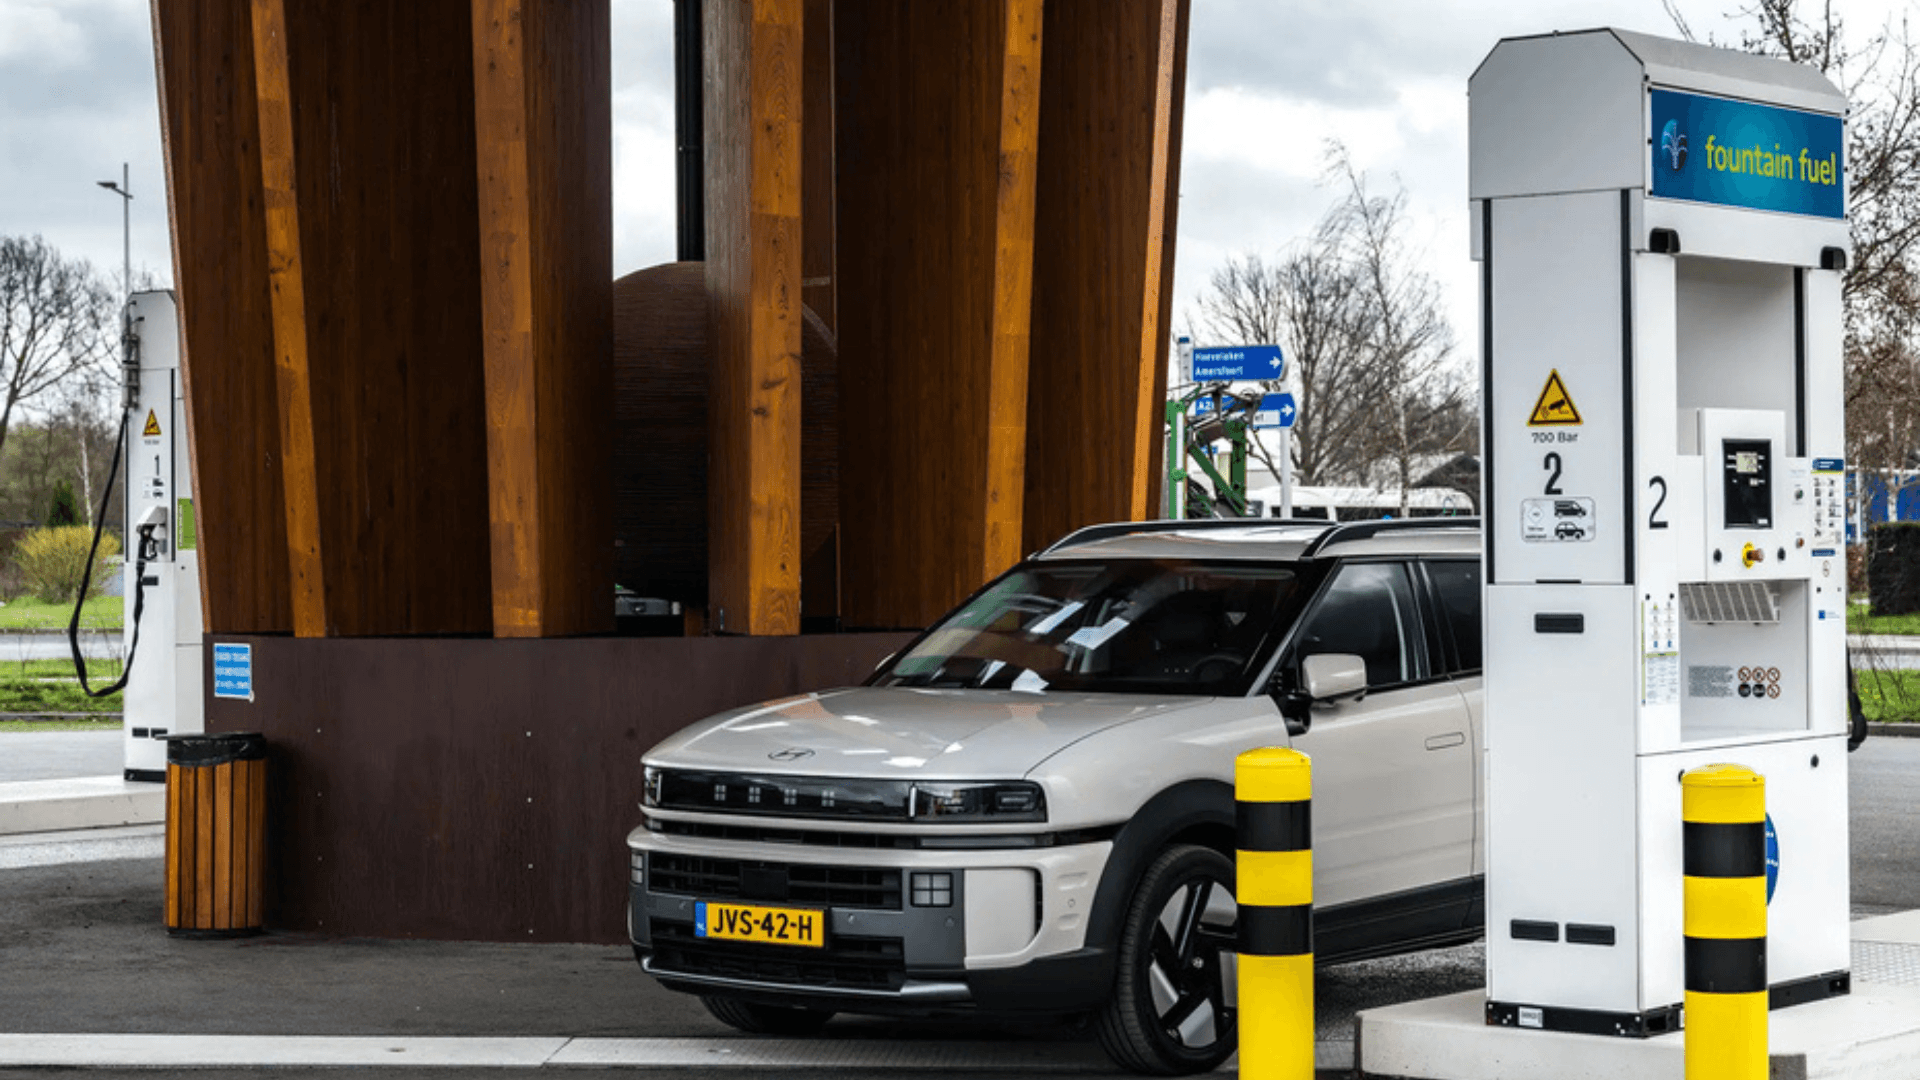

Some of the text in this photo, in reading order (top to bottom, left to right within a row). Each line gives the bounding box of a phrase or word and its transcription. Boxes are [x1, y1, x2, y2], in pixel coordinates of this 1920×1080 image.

[1705, 134, 1836, 185] fountain fuel
[1531, 431, 1578, 443] 700 Bar
[154, 454, 160, 476] 1
[1544, 452, 1562, 495] 2
[1649, 475, 1668, 530] 2
[714, 908, 812, 941] JVS-42-H
